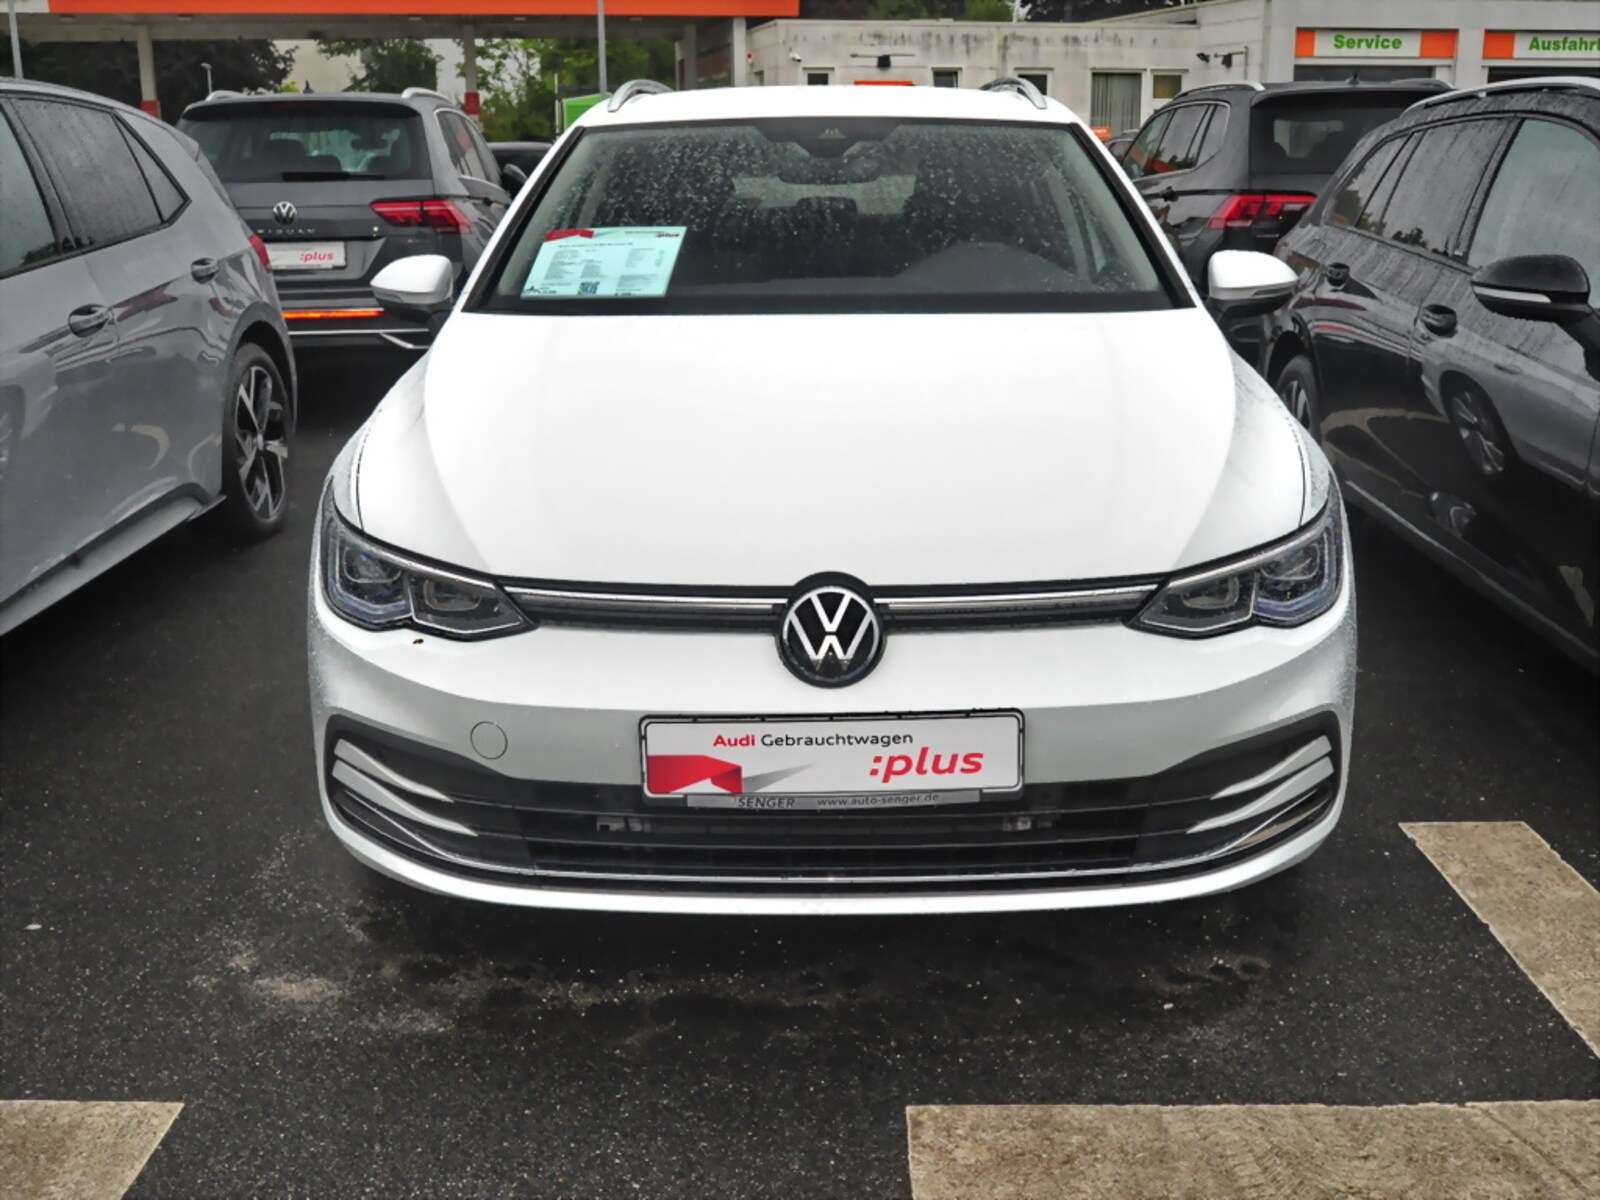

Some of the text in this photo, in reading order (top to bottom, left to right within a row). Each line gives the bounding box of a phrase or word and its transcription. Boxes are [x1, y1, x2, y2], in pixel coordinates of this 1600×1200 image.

[1333, 33, 1403, 50] Service
[713, 733, 914, 748] Audi Gebrauchtwagen
[738, 793, 939, 809] SENGER www.auto-senger.de
